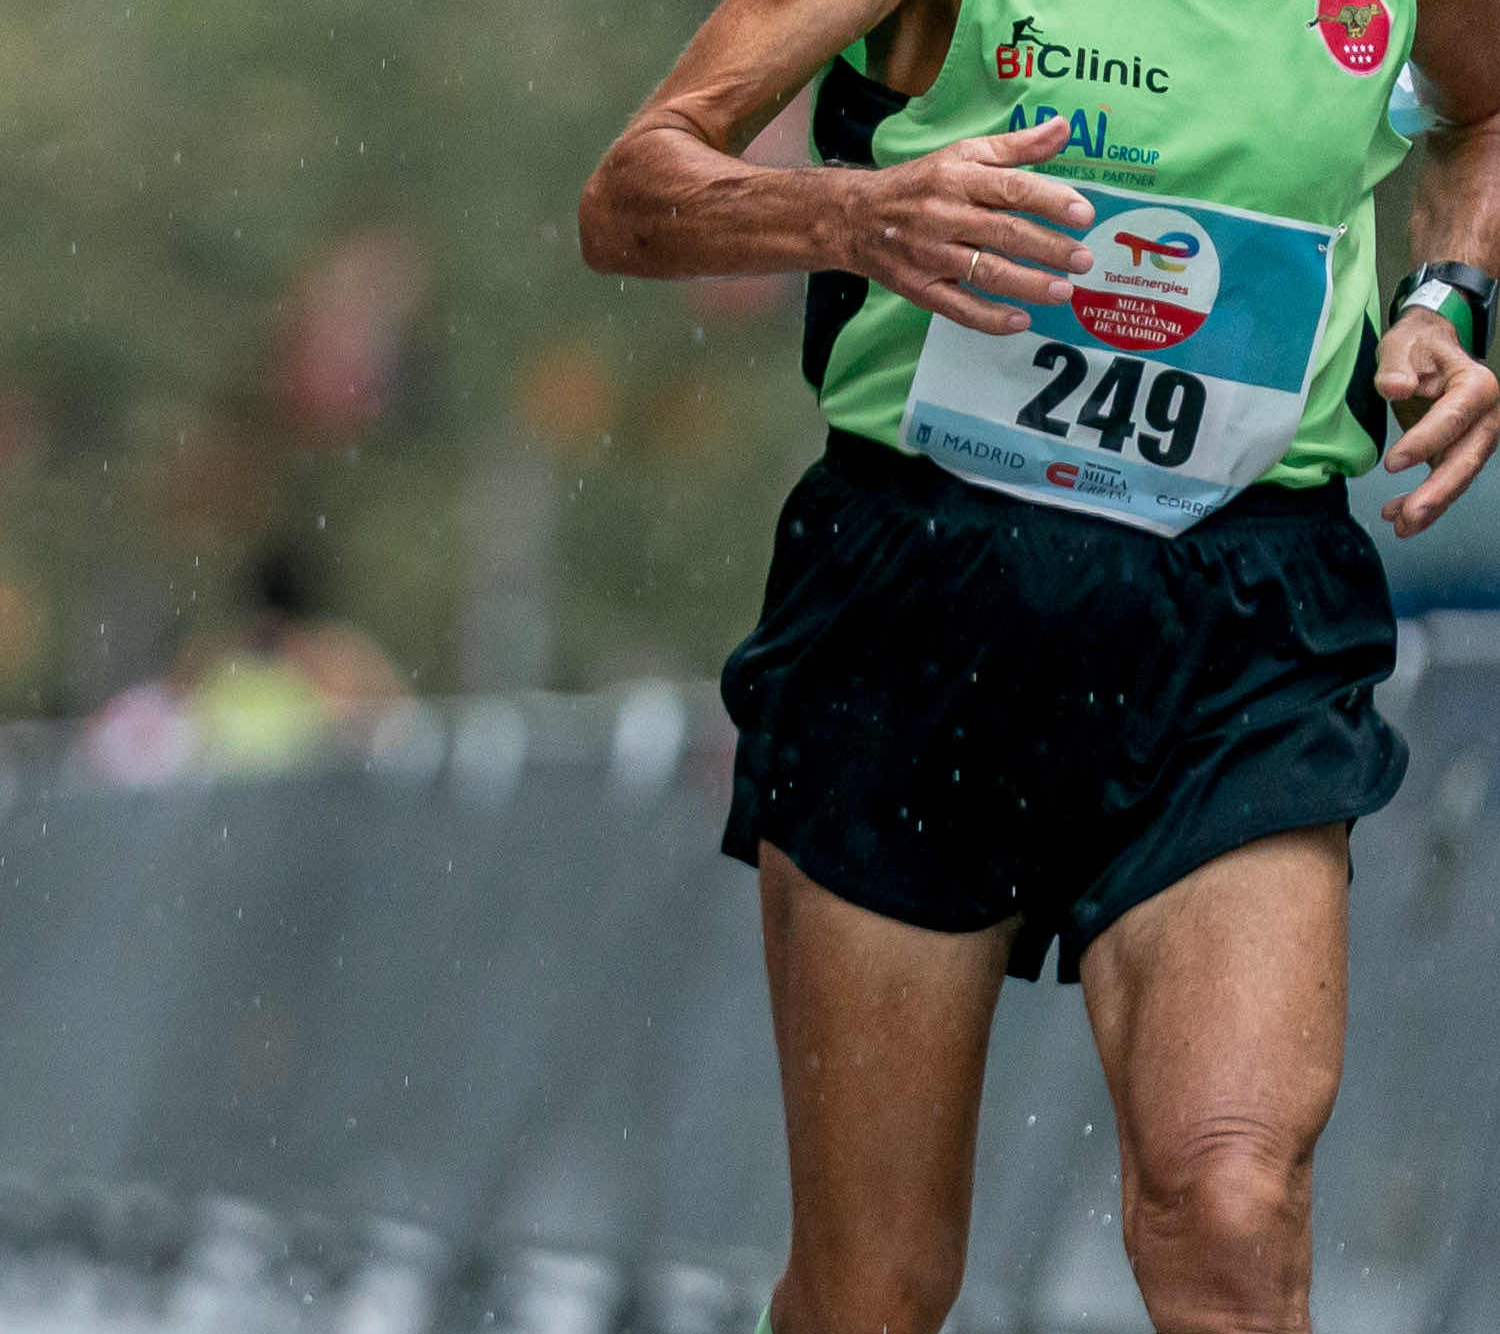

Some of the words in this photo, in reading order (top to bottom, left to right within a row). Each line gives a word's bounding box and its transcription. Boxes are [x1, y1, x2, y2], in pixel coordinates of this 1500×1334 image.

[996, 44, 1170, 94] BiClinic
[1107, 144, 1160, 165] GROUP
[1102, 170, 1157, 187] PARTNER
[1104, 271, 1188, 295] TotalEnergies
[1116, 298, 1157, 315] MILLA
[1082, 305, 1185, 336] INTERNACIONAL
[1093, 319, 1112, 333] DE
[1116, 325, 1168, 344] MADRID
[1015, 341, 1207, 468] 249
[943, 433, 1025, 469] MADRID
[1081, 468, 1128, 491] MILLA
